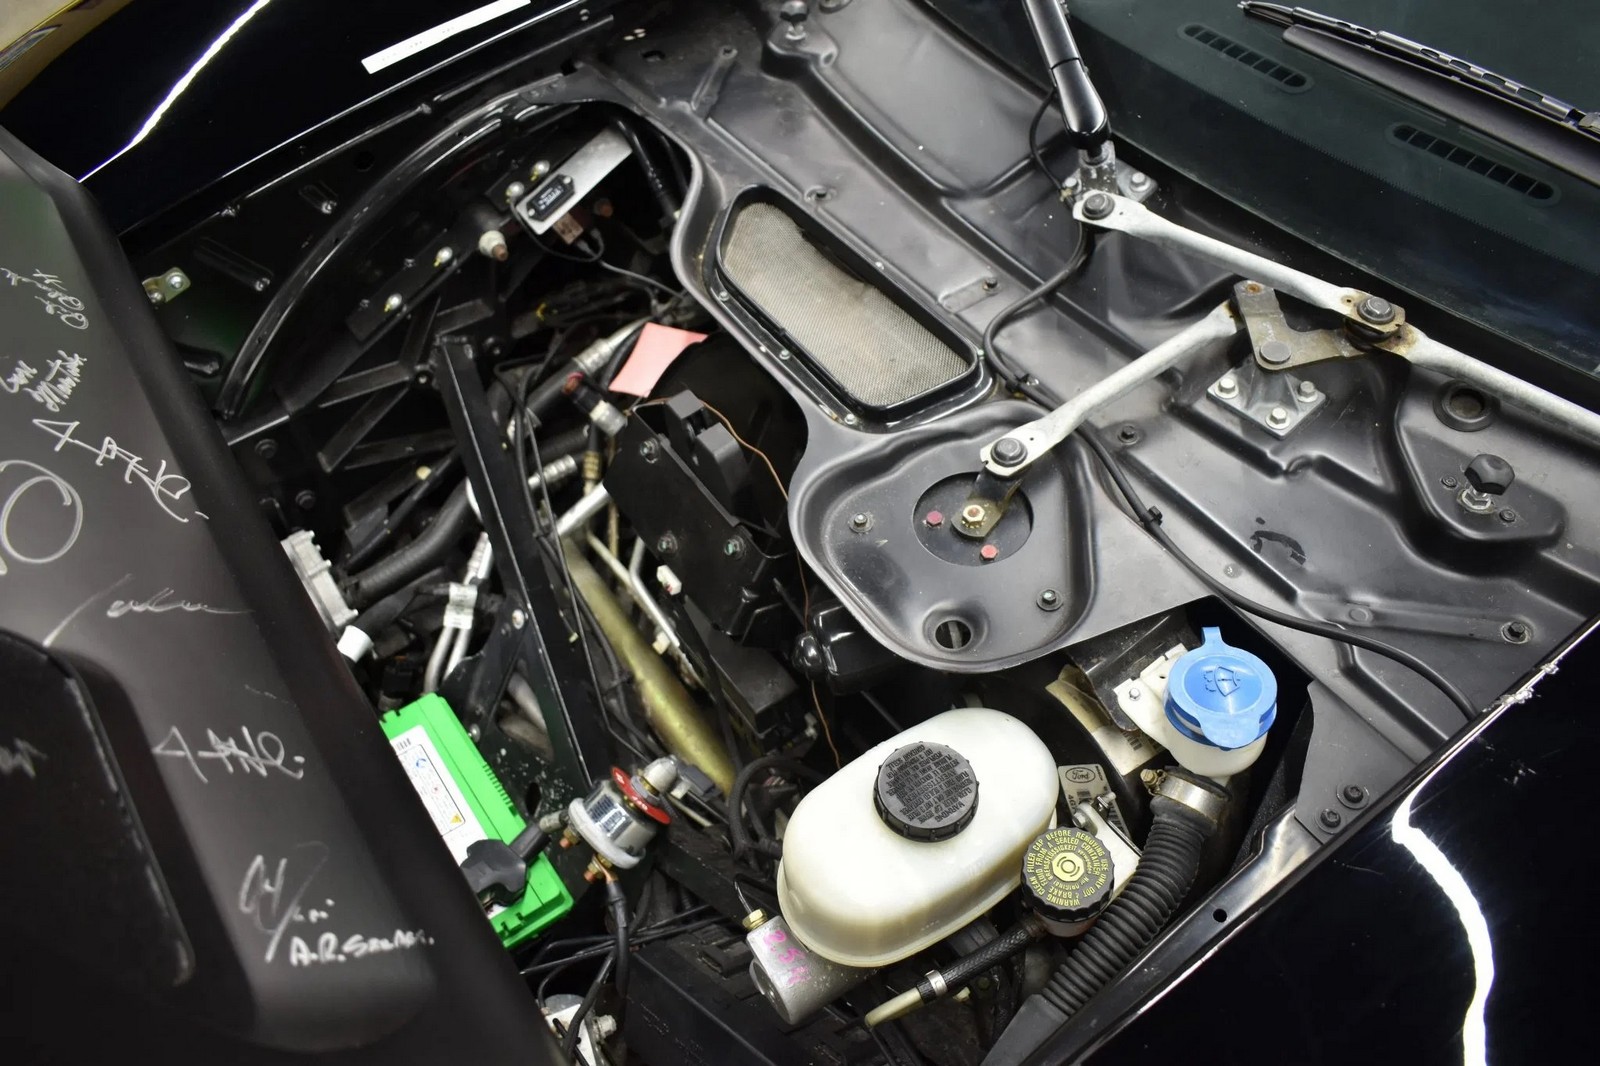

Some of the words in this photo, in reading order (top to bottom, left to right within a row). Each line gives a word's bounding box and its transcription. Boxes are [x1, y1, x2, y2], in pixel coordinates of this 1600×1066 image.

[1072, 769, 1089, 780] Ford
[1046, 829, 1072, 840] BEFORE
[1055, 837, 1079, 845] SEALED
[1033, 839, 1044, 851] CAP
[1076, 831, 1105, 857] REMOVING
[1027, 852, 1036, 873] FILLER
[1035, 848, 1048, 866] FROM
[1081, 842, 1101, 875] CONTAINER
[1101, 859, 1109, 871] USE
[1035, 868, 1048, 886] FLUID
[1096, 874, 1107, 889] ONLY
[1029, 877, 1045, 896] CLEAN
[1048, 886, 1073, 899] BRAKE
[1083, 886, 1095, 897] DOT
[1046, 895, 1080, 907] WARNING
